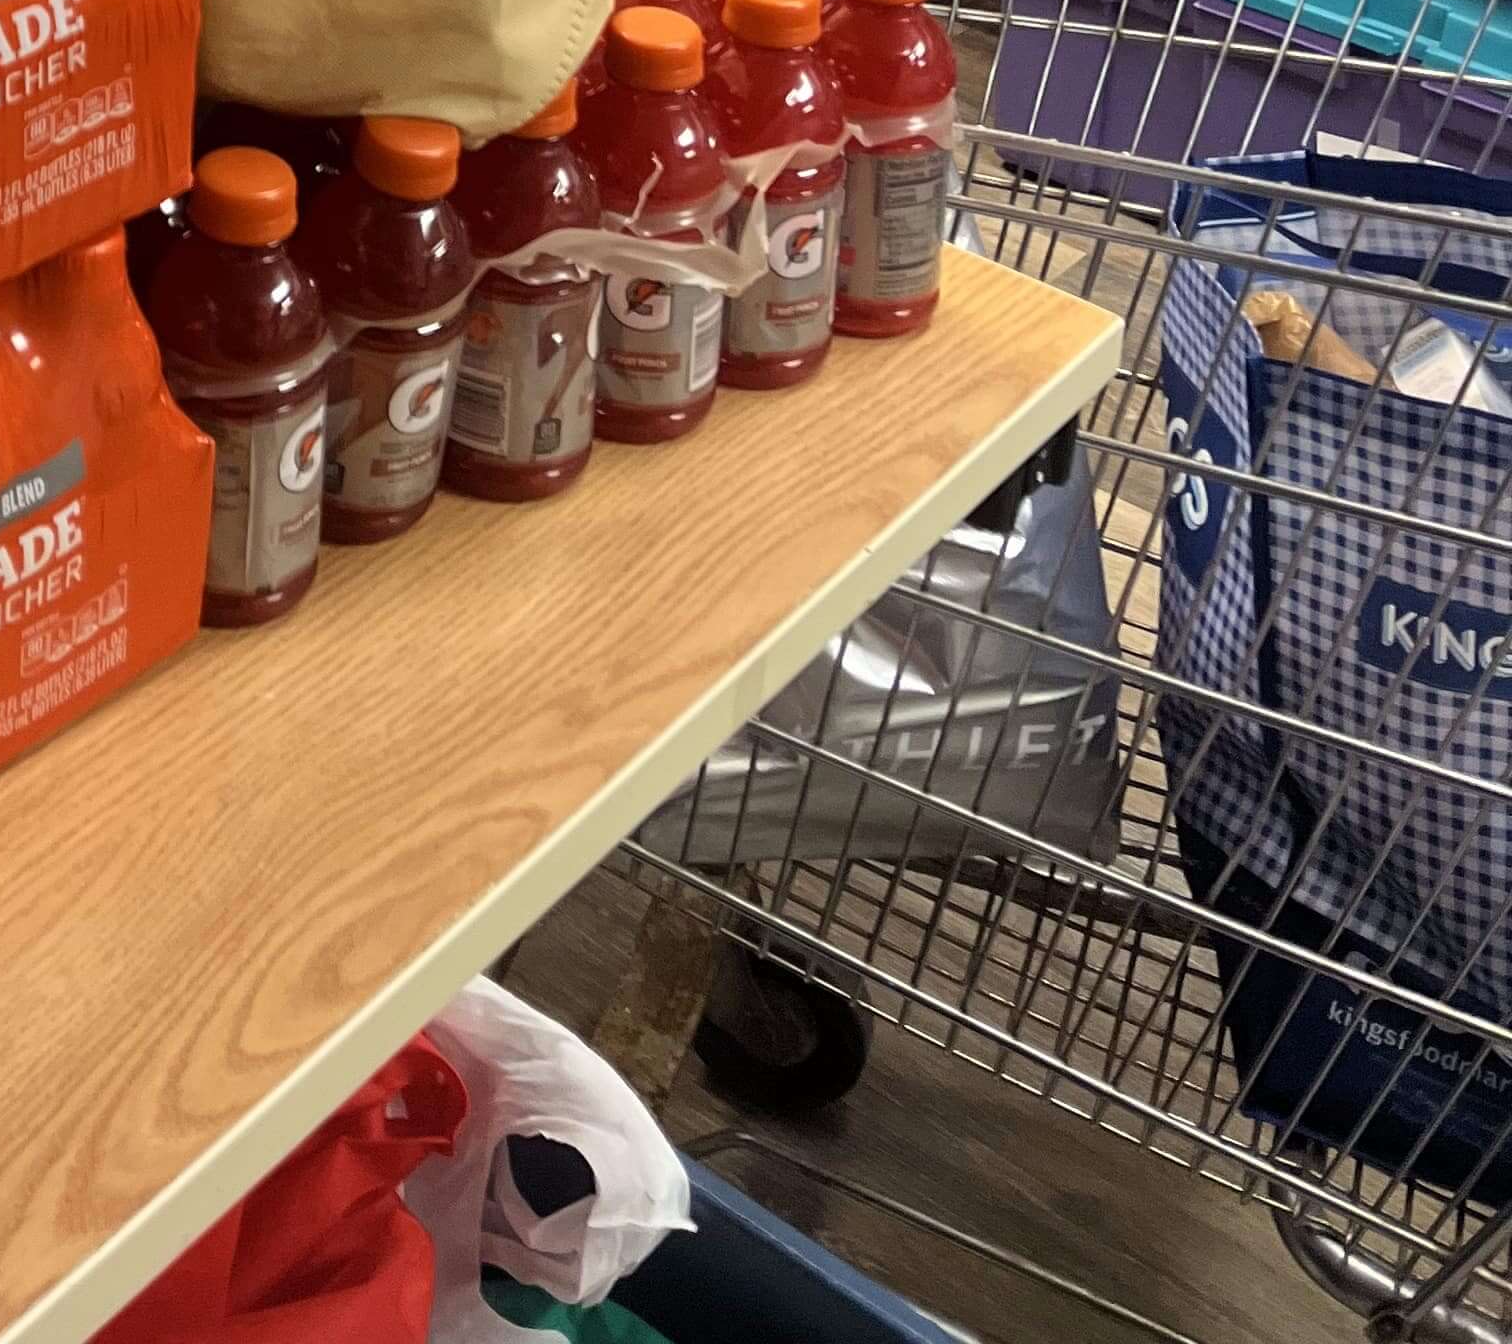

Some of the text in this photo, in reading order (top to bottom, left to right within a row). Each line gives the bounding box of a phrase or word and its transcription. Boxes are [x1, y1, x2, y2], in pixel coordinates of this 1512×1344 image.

[766, 210, 825, 280] G
[388, 361, 448, 434] G
[279, 406, 325, 494] G
[0, 475, 46, 519] BLEND
